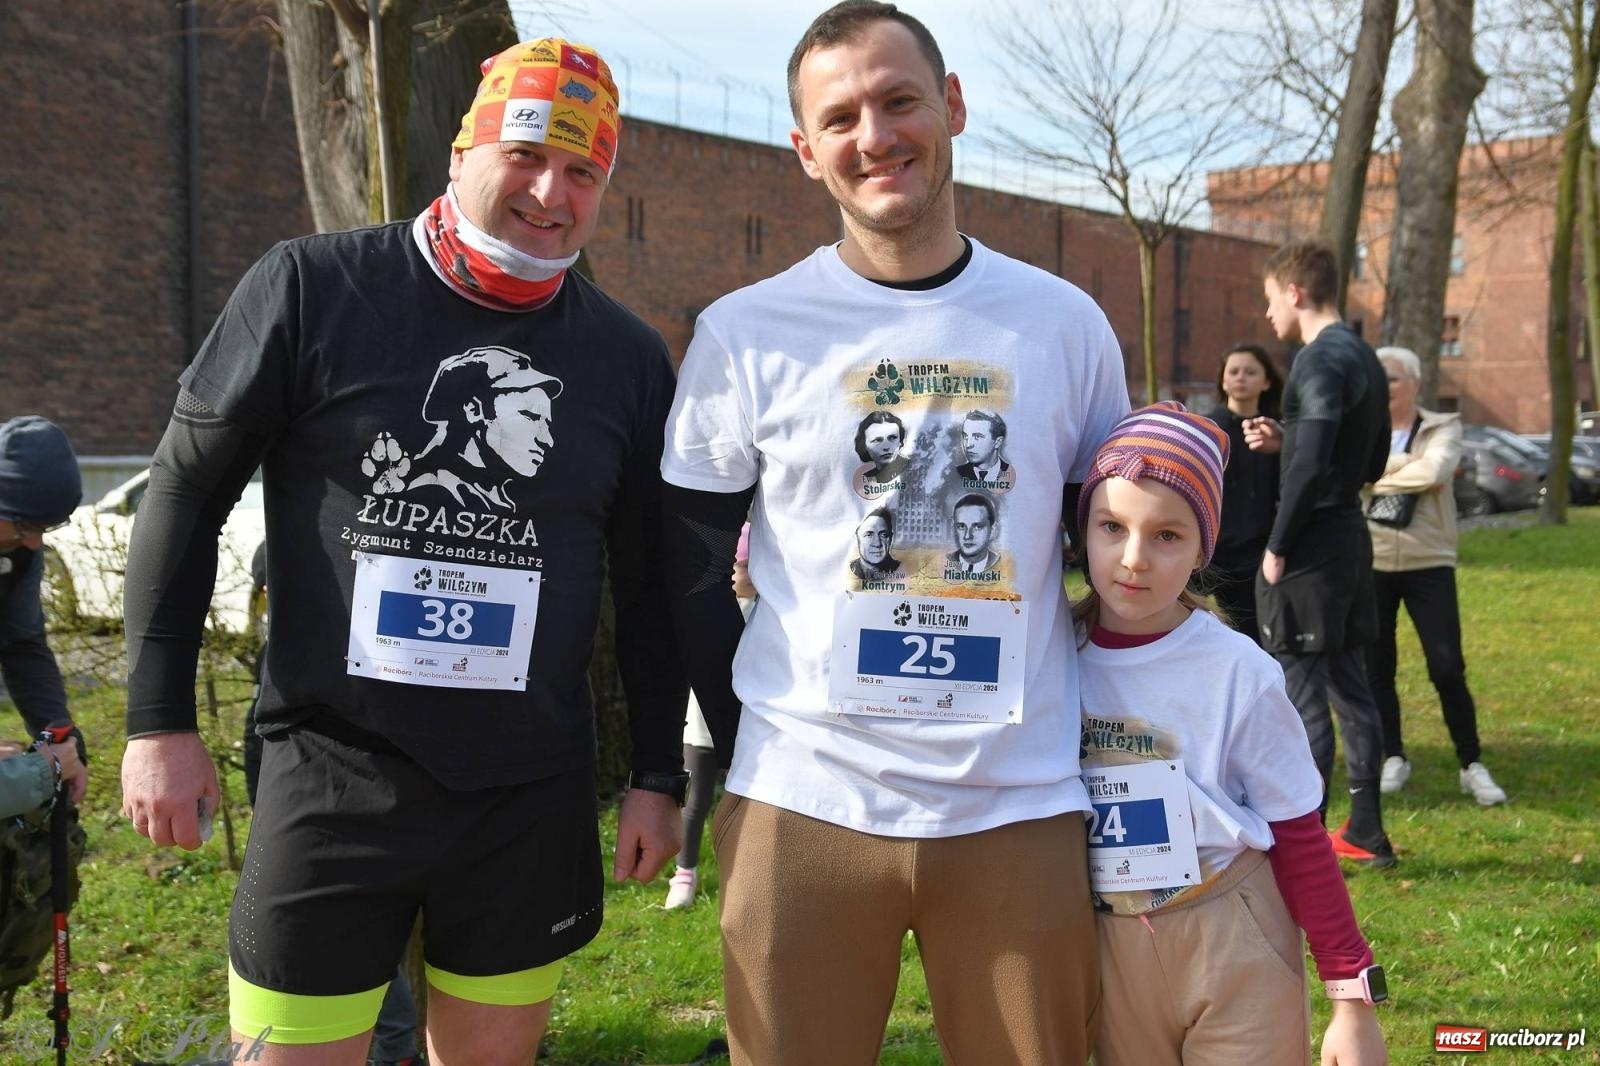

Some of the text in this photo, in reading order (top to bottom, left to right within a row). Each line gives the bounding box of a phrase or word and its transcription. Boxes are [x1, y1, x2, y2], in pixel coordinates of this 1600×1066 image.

[908, 364, 949, 376] TROPEM
[863, 480, 906, 495] Stolarska
[963, 477, 1010, 489] Rodowicz
[356, 494, 539, 547] ŁUPASZKA
[341, 526, 543, 568] Zygmunt Szendzielarz
[438, 569, 465, 579] TROPEM
[944, 569, 1001, 581] Miatkowski
[862, 580, 905, 593] Kontrym
[918, 604, 945, 613] TROPEM
[417, 599, 474, 640] 38
[376, 637, 392, 646] 1963
[900, 635, 955, 675] 25
[857, 676, 874, 684] 1963
[939, 711, 965, 719] Centrum
[966, 712, 989, 721] Kultury
[1088, 718, 1125, 733] TROPEM
[1087, 775, 1106, 783] TROPEM
[1088, 805, 1127, 843] 24
[1157, 845, 1172, 853] 2024
